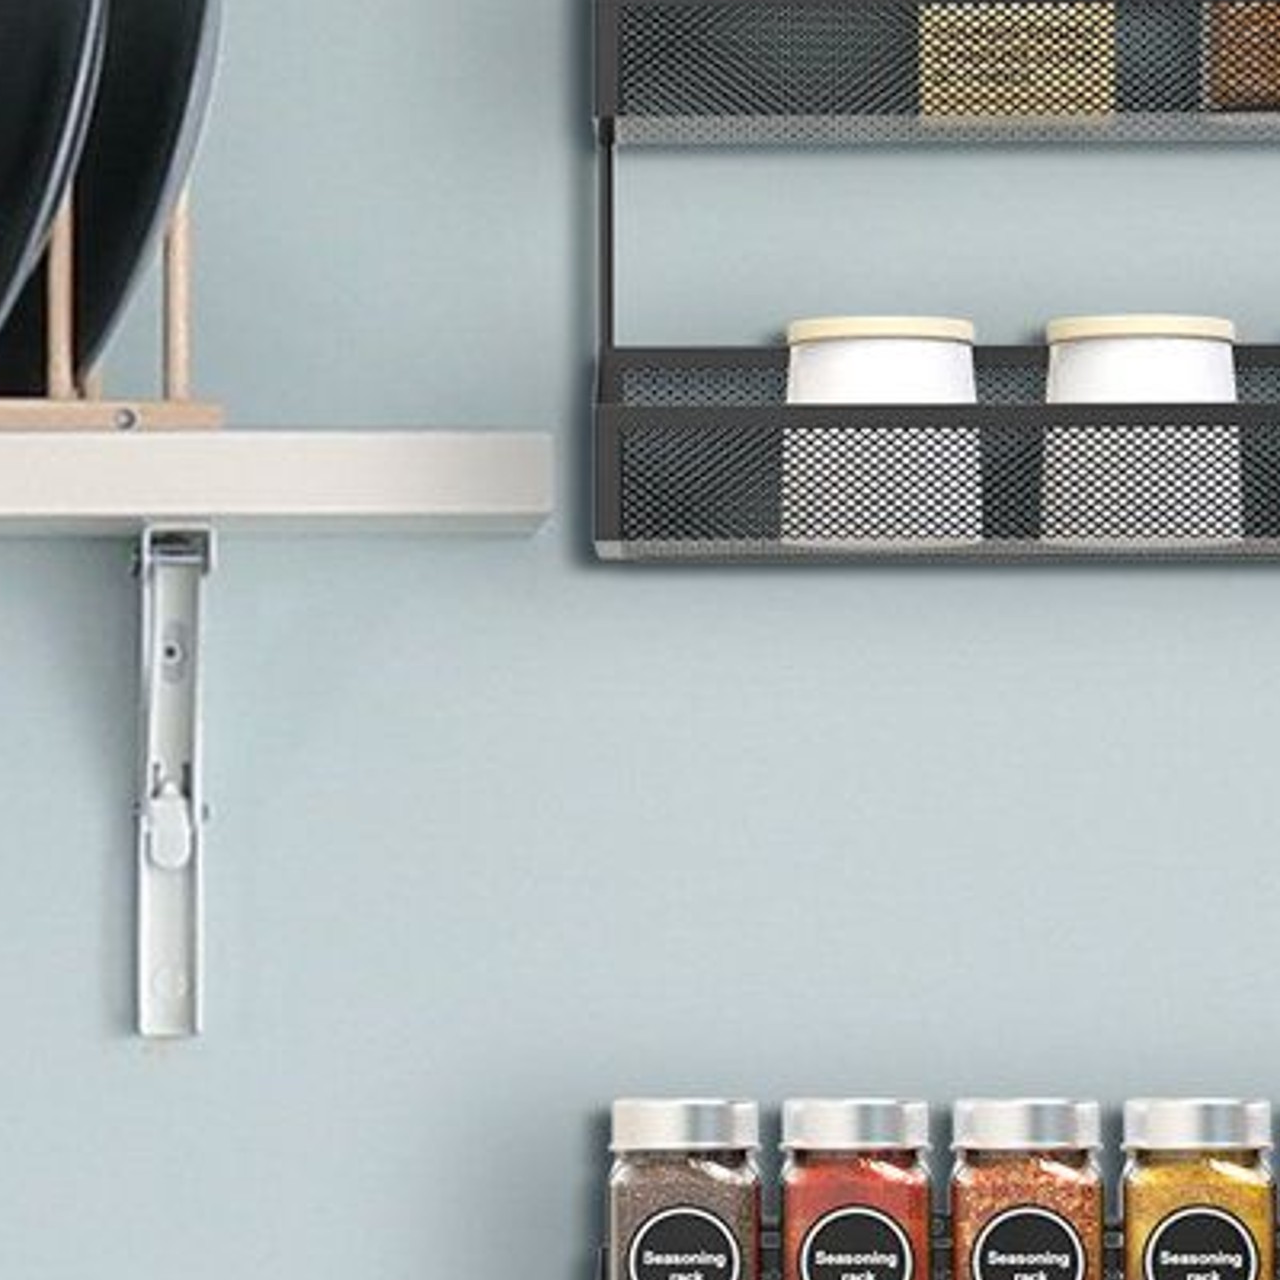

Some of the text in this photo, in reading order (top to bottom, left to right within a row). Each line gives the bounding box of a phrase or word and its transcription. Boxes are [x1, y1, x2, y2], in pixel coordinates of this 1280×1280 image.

[642, 1250, 727, 1269] Seasoning
[815, 1250, 898, 1269] Seasoning
[987, 1250, 1071, 1269] Seasoning
[1160, 1250, 1243, 1269] Seasoning
